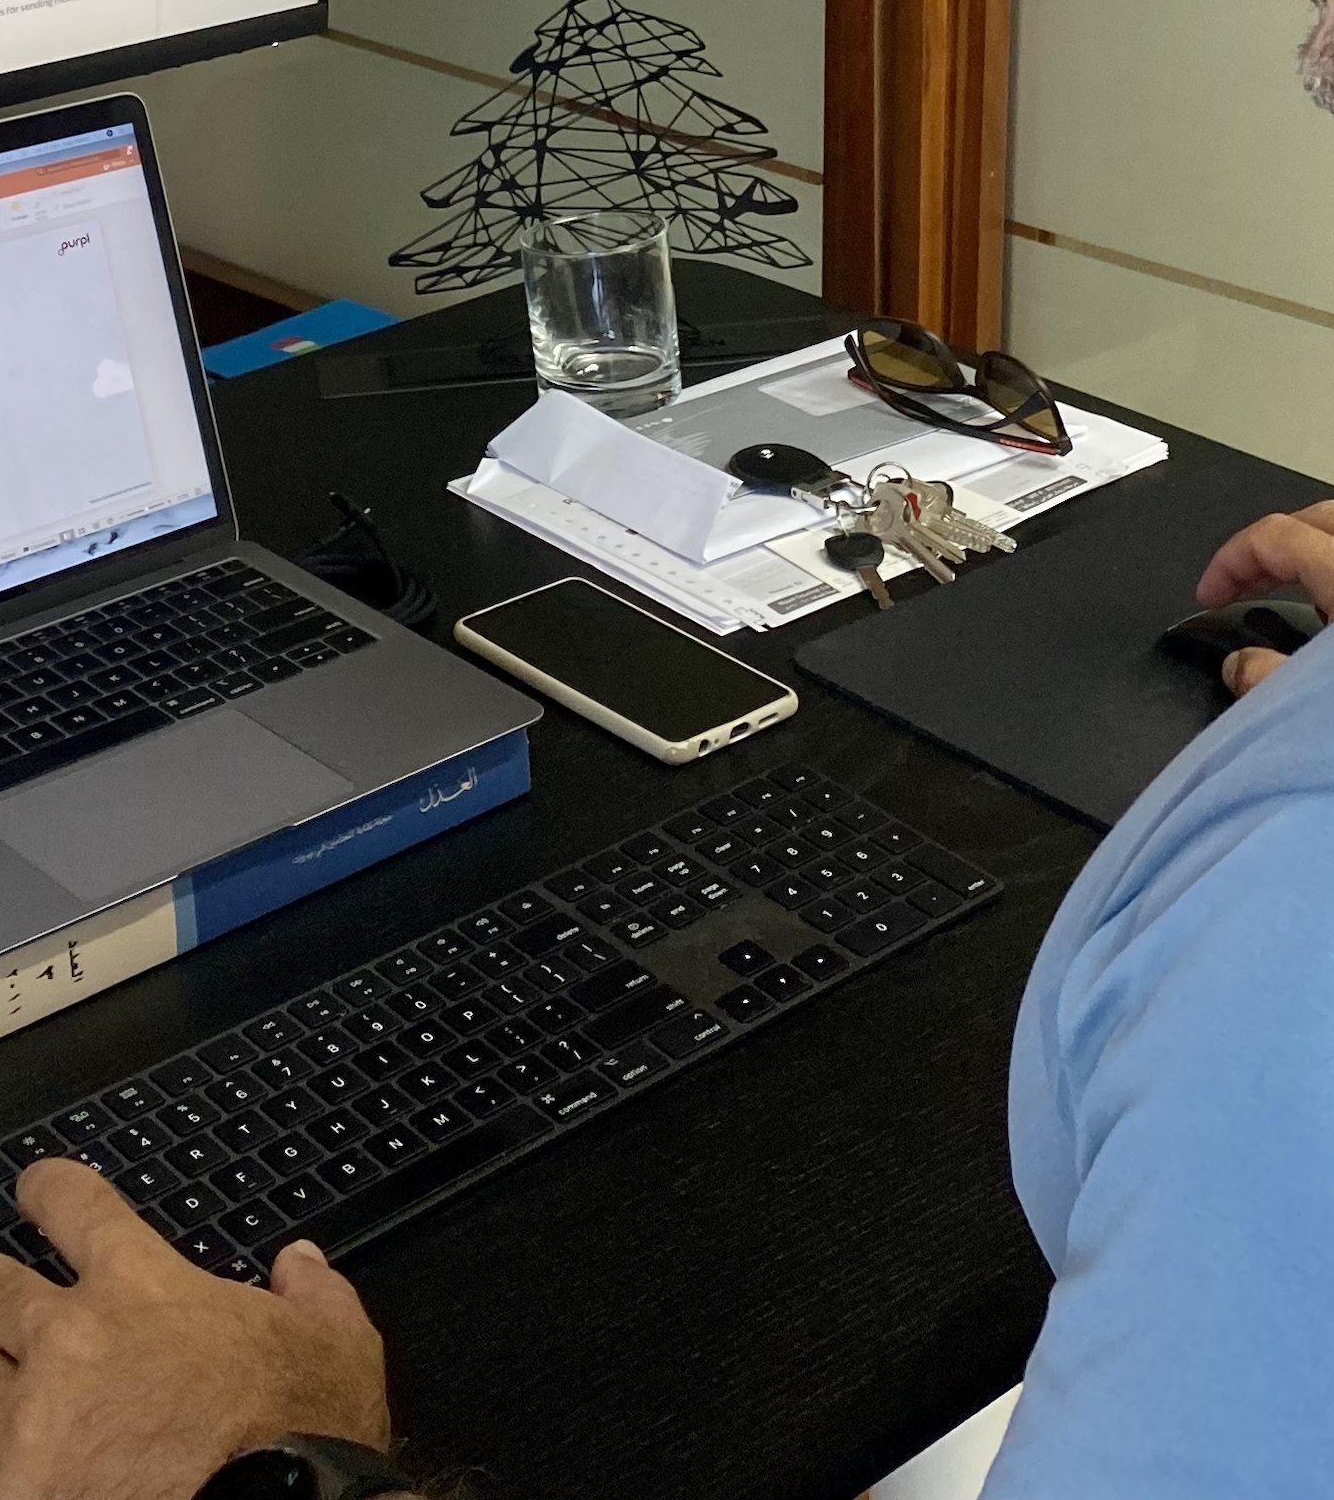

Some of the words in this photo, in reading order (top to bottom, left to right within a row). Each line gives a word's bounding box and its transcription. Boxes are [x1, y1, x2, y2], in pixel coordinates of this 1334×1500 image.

[20, 0, 53, 11] sending
[58, 234, 91, 256] purpl
[557, 926, 579, 940] delete
[625, 974, 649, 988] return
[695, 1024, 721, 1042] control
[141, 1174, 155, 1184] E
[189, 1150, 203, 1160] R
[239, 1124, 249, 1134] T
[285, 1100, 297, 1110] Y
[331, 1076, 345, 1088] U
[421, 1032, 433, 1042] O
[463, 1010, 473, 1020] P
[559, 1091, 597, 1116] command
[623, 1064, 648, 1081] option
[185, 1198, 199, 1208] D
[235, 1172, 245, 1182] F
[285, 1148, 297, 1156] G
[331, 1122, 345, 1134] H
[421, 1076, 435, 1086] K
[465, 1054, 479, 1062] L
[245, 1216, 259, 1226] C
[293, 1188, 305, 1198] V
[341, 1164, 355, 1174] B
[389, 1138, 403, 1150] N
[433, 1114, 449, 1126] M
